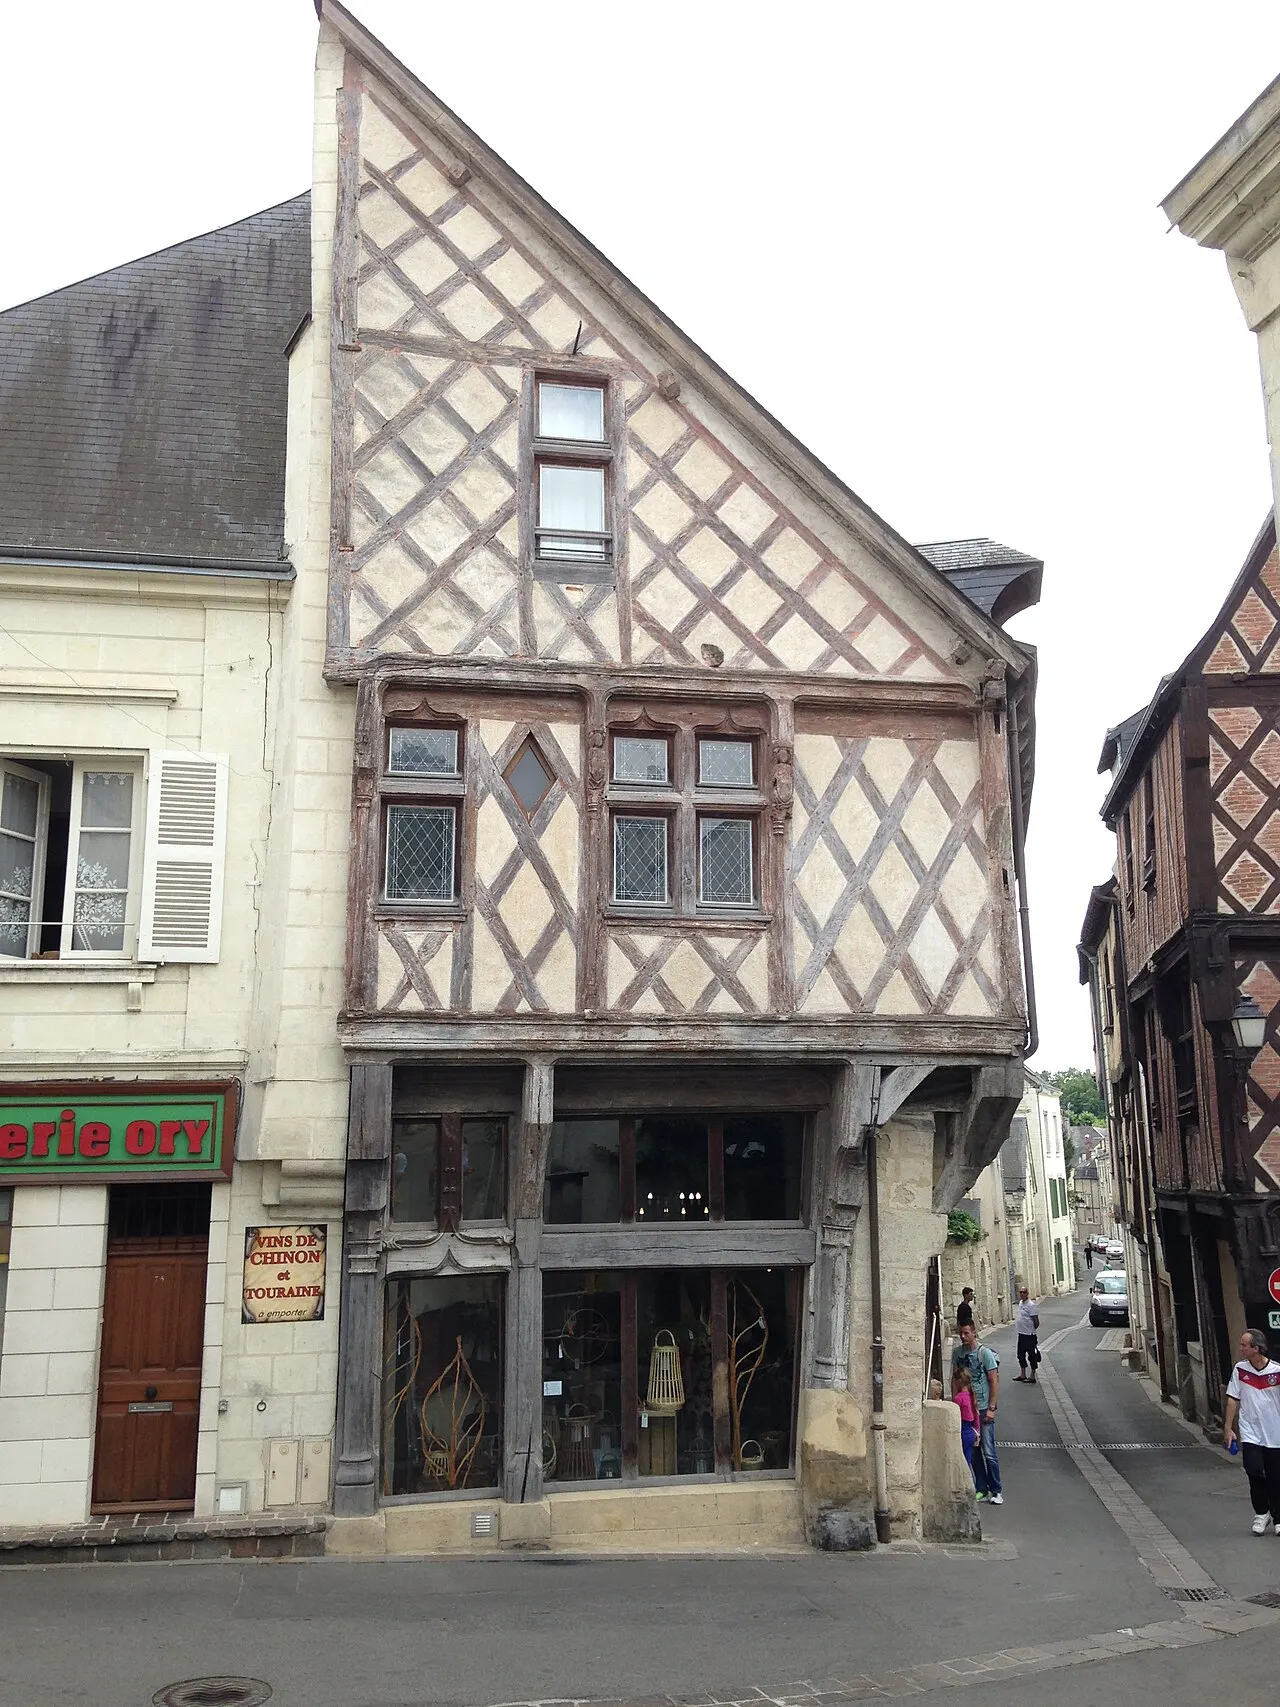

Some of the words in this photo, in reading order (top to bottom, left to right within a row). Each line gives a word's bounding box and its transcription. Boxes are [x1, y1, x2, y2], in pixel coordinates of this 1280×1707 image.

[256, 1235, 293, 1248] VINS
[296, 1234, 318, 1247] DE
[250, 1250, 321, 1265] CHINON
[277, 1270, 290, 1281] et
[245, 1285, 321, 1299] TOURAINE
[266, 1308, 307, 1319] emporter
